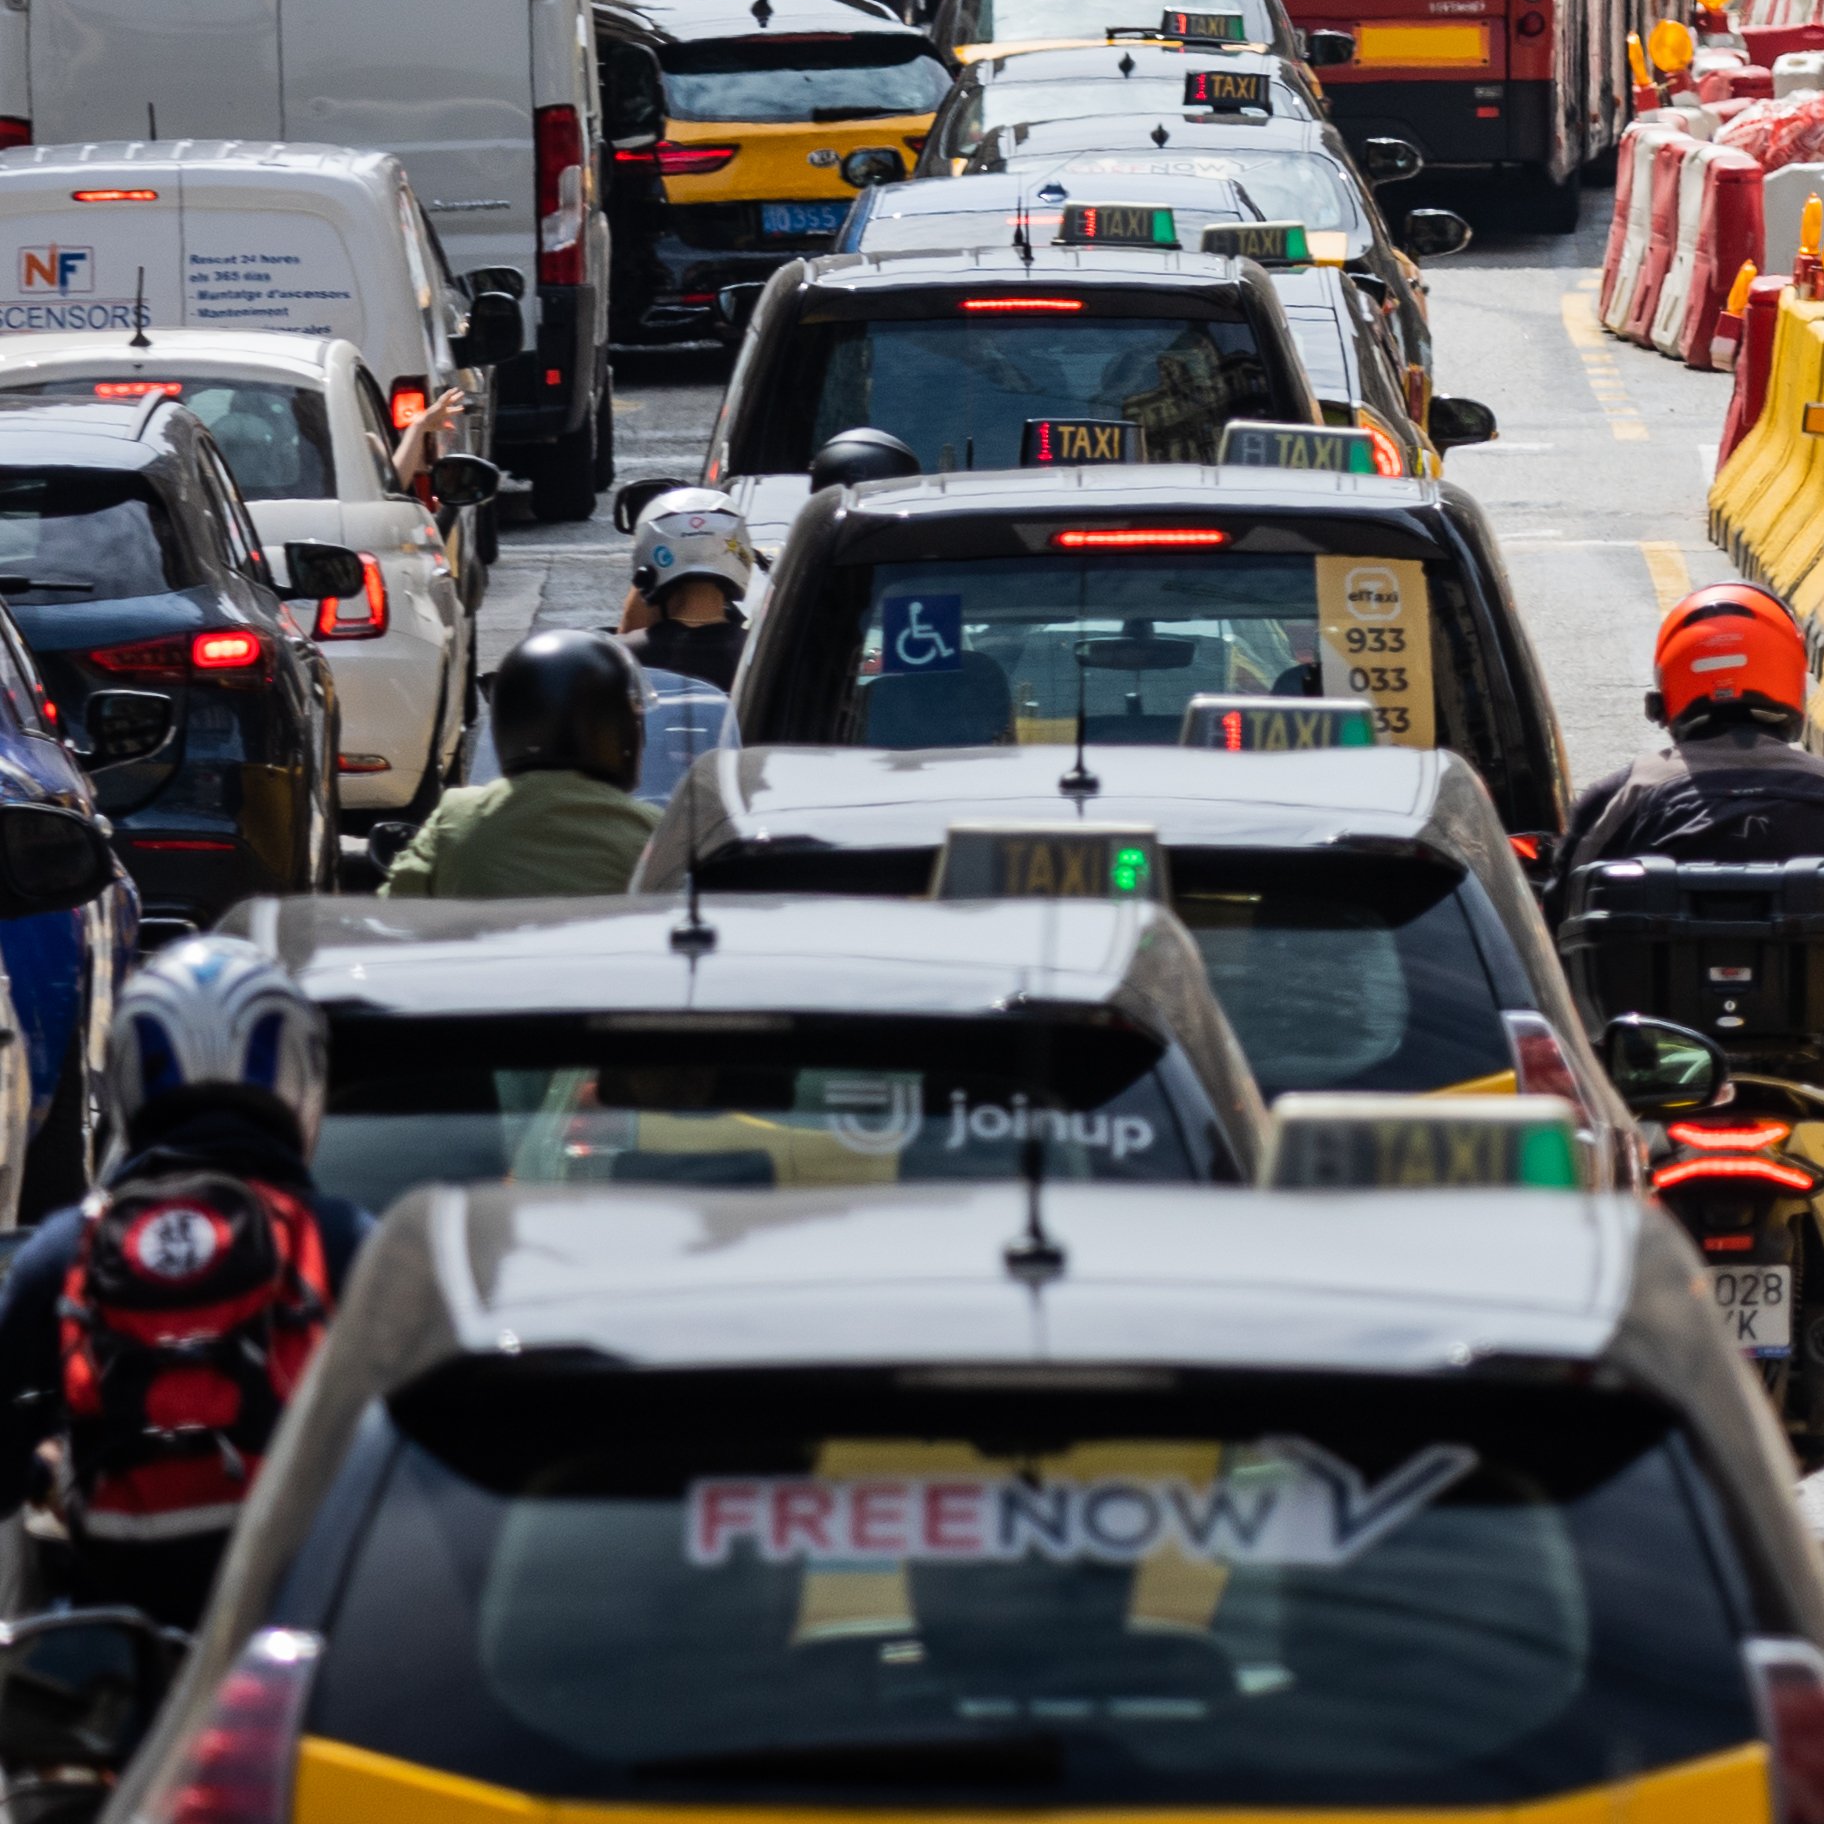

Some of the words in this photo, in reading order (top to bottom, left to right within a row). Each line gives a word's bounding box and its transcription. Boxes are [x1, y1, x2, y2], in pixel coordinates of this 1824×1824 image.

[1211, 73, 1258, 100] TAXI
[1099, 210, 1149, 238] TAXI
[1236, 229, 1285, 257] TAXI
[190, 255, 237, 265] Rescat
[1058, 425, 1121, 460] TAXI
[1277, 433, 1344, 471] TAXI
[1345, 628, 1406, 654] 933
[1349, 667, 1409, 692] 033
[1250, 712, 1333, 748] TAXI
[1002, 843, 1103, 897] TAXI
[946, 1091, 1156, 1160] joinup
[1716, 1273, 1782, 1306] 028
